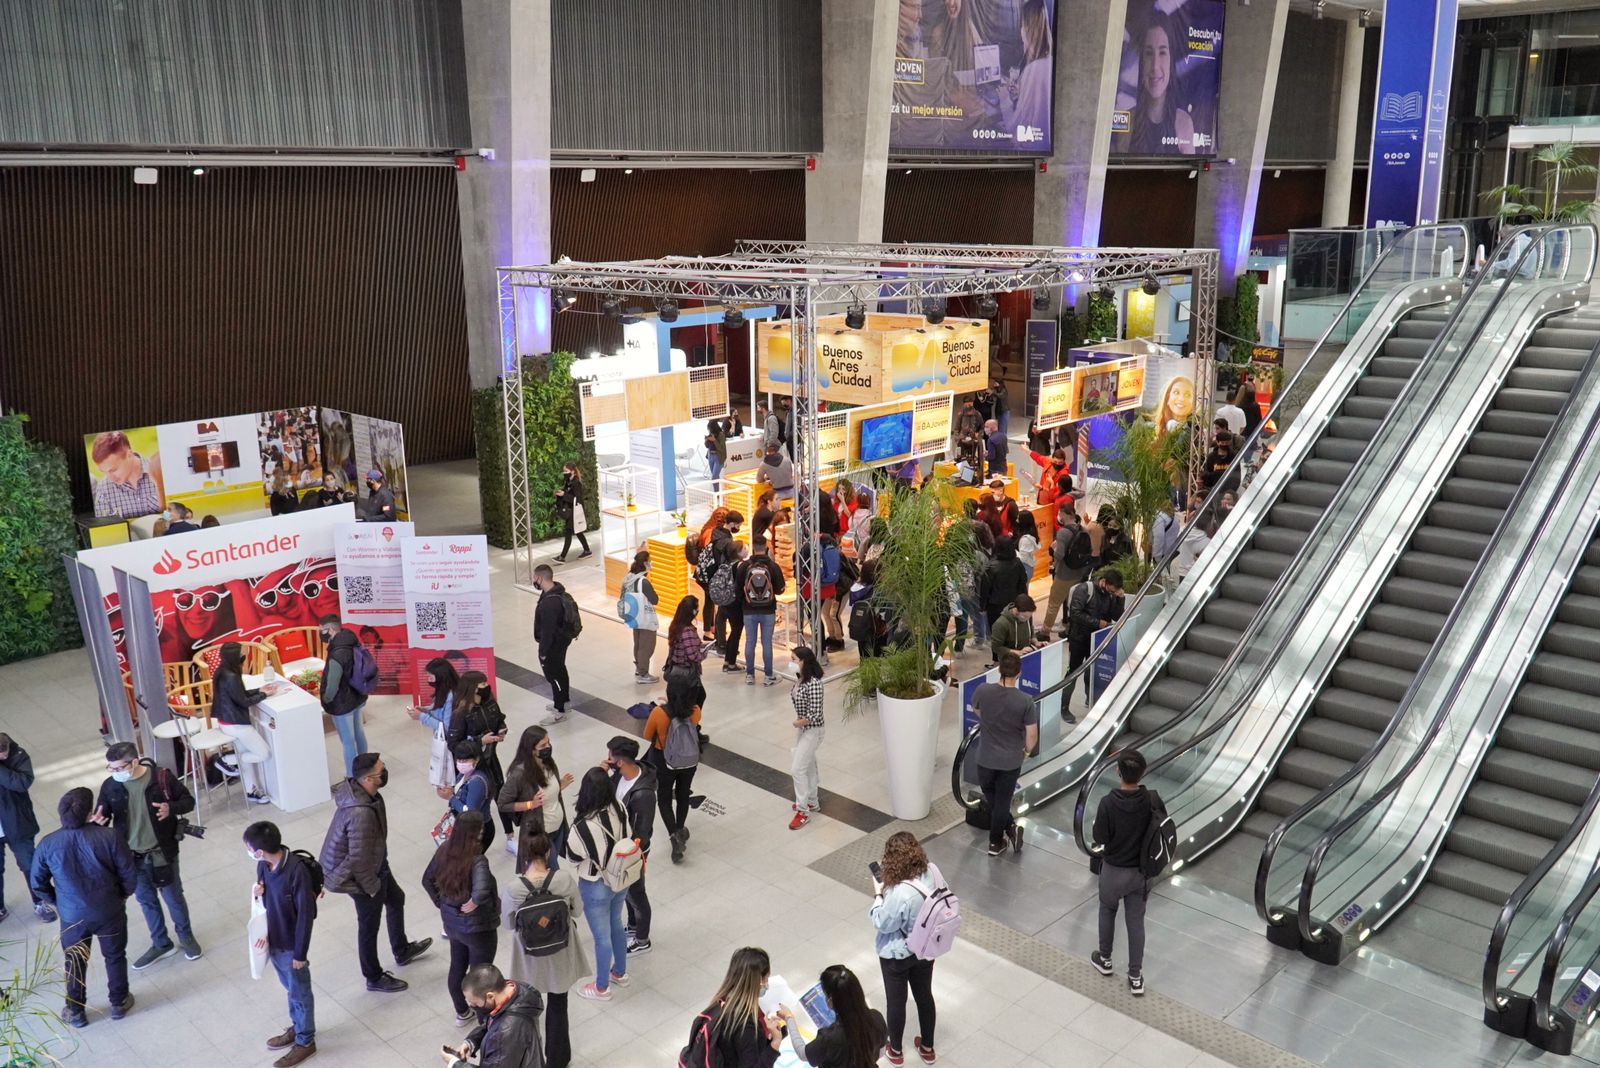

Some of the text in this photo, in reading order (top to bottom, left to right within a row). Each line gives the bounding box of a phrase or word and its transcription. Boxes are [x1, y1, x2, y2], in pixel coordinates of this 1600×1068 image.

[896, 62, 922, 74] JOVEN
[902, 104, 910, 114] tu
[912, 105, 934, 116] mejor
[937, 105, 963, 116] versión
[1017, 125, 1034, 142] BA
[822, 344, 863, 360] Buenos
[942, 340, 975, 354] Buenos
[948, 353, 972, 365] Aires
[829, 360, 859, 373] Aires
[950, 361, 981, 378] Ciudad
[832, 372, 872, 388] Ciudad
[1047, 393, 1066, 404] EXPO
[197, 421, 219, 435] BA
[185, 533, 300, 570] Santander
[449, 543, 473, 554] Rappi
